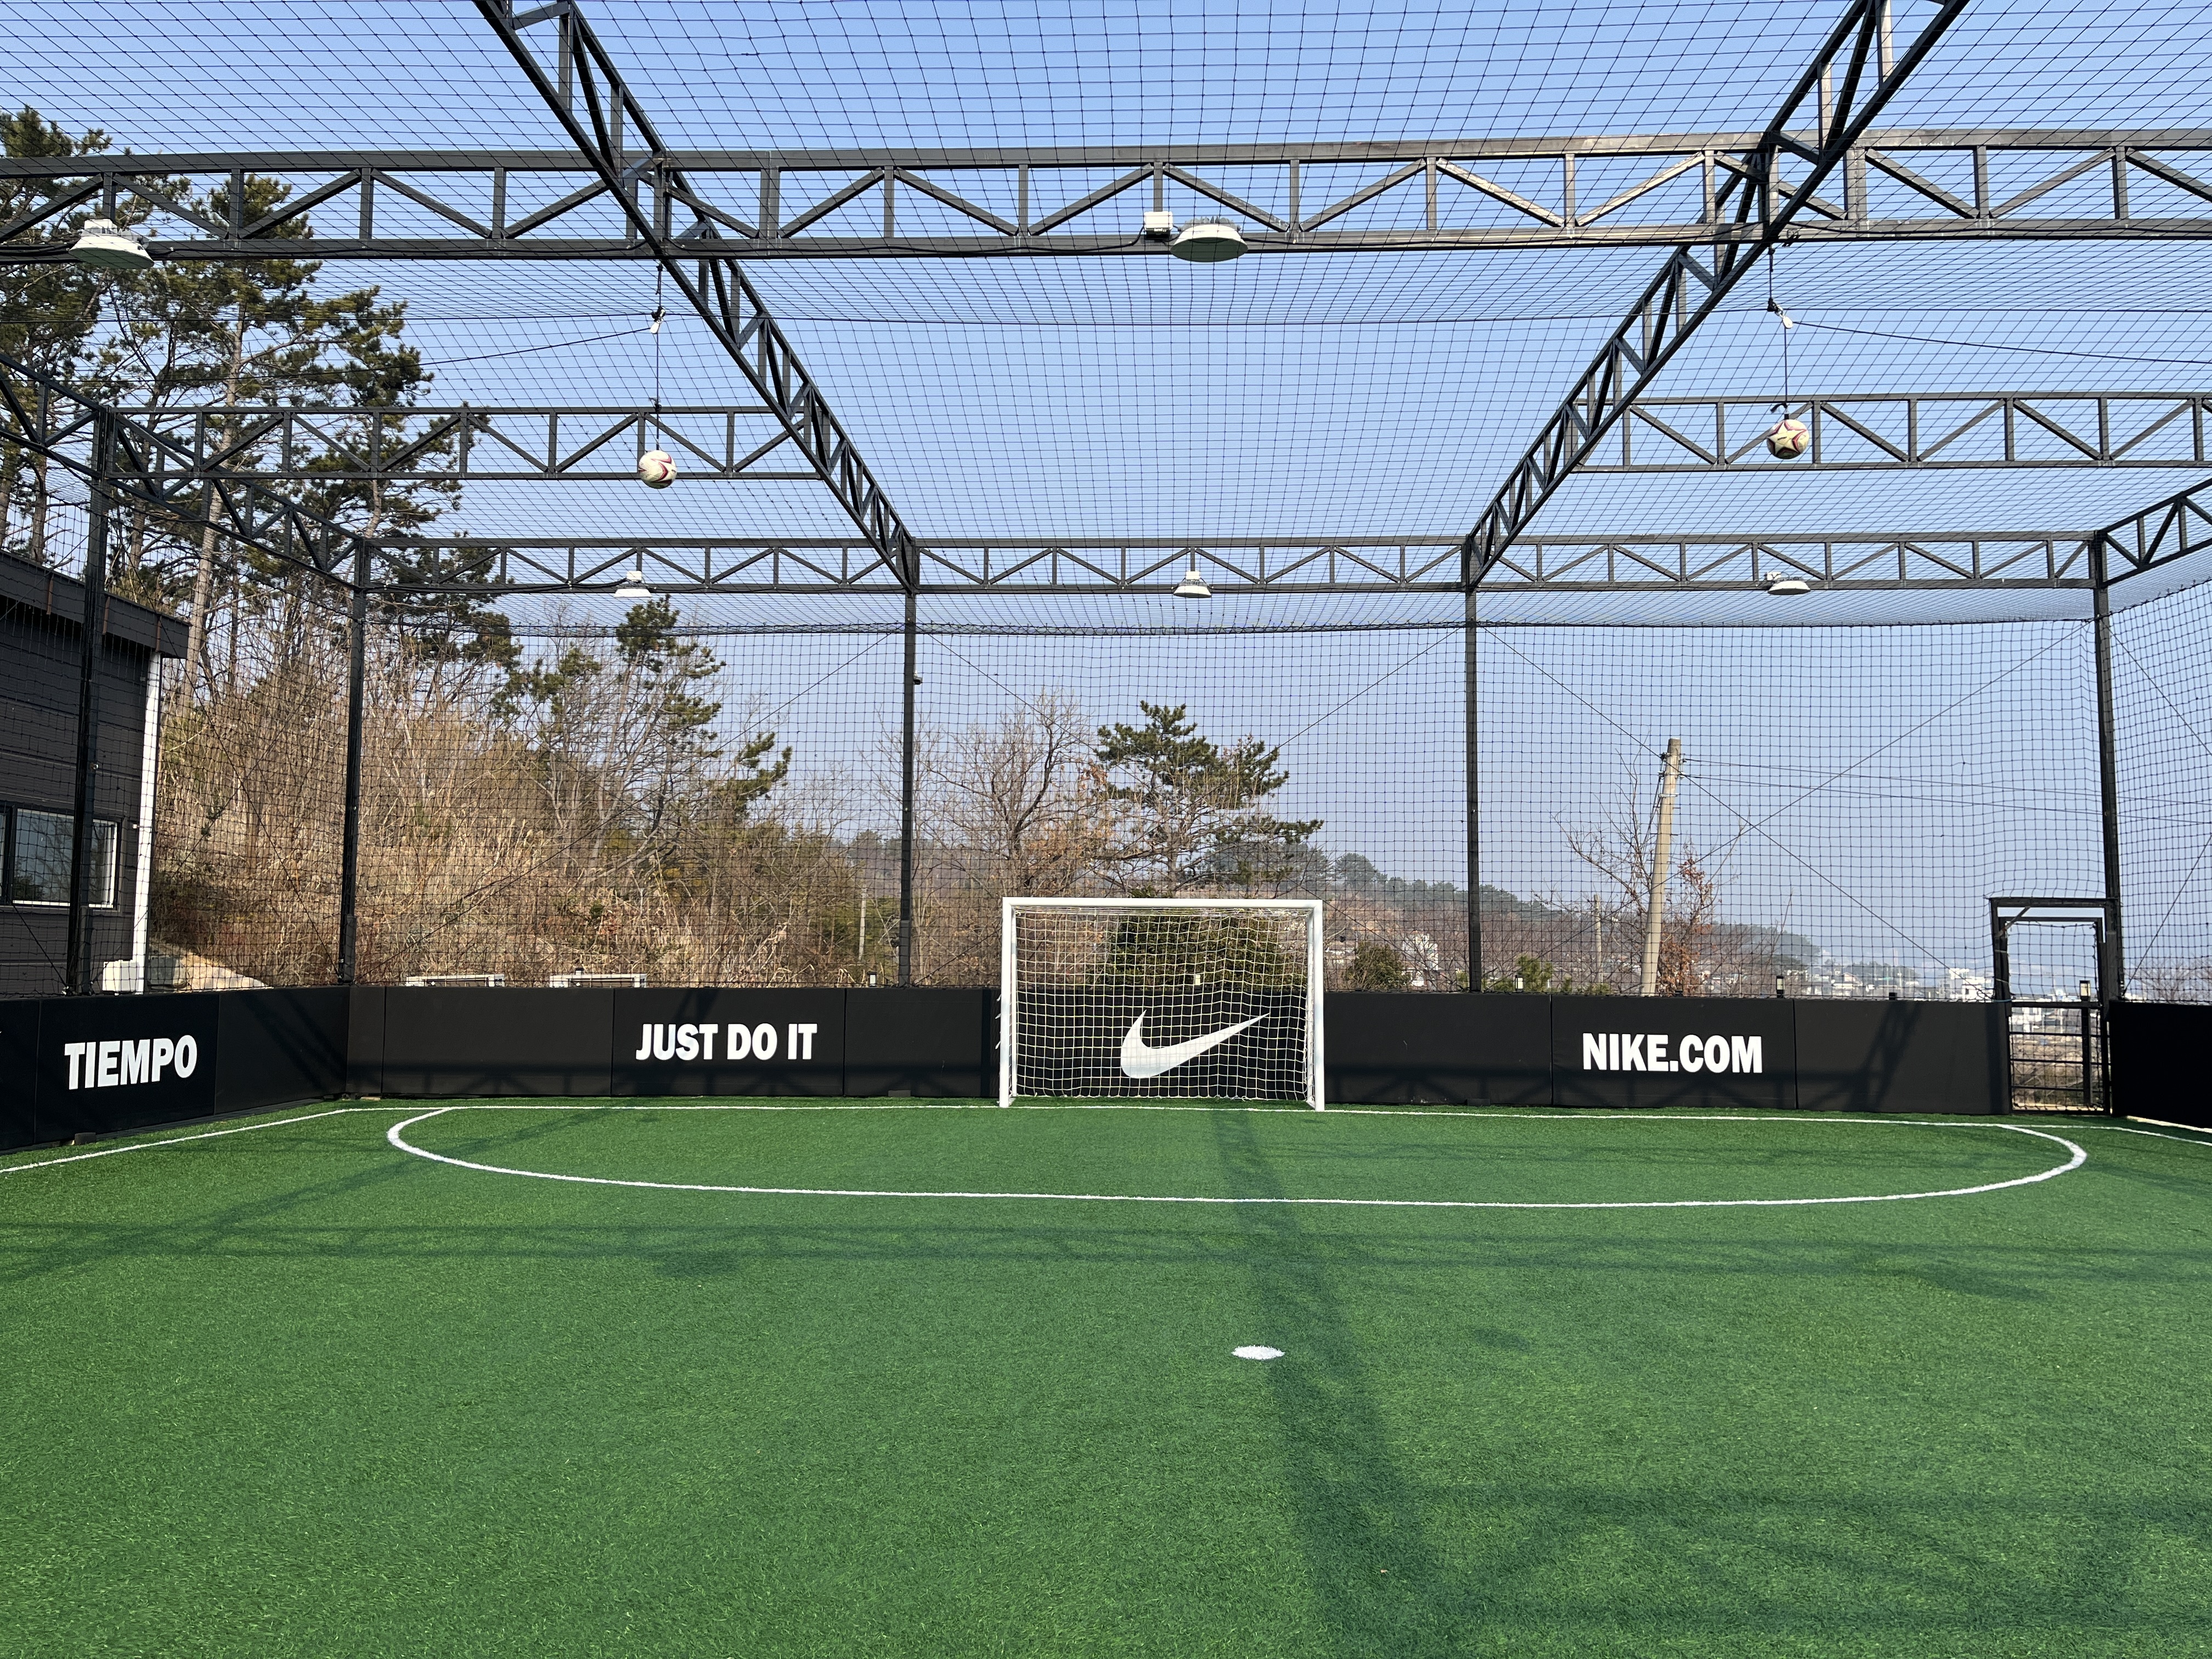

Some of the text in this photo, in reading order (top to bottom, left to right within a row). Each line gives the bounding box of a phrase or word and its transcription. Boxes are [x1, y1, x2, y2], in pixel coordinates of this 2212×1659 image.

[635, 1023, 817, 1060] JUST DO IT
[1583, 1032, 1763, 1073] NIKE.COM
[64, 1035, 198, 1090] TIEMPO
